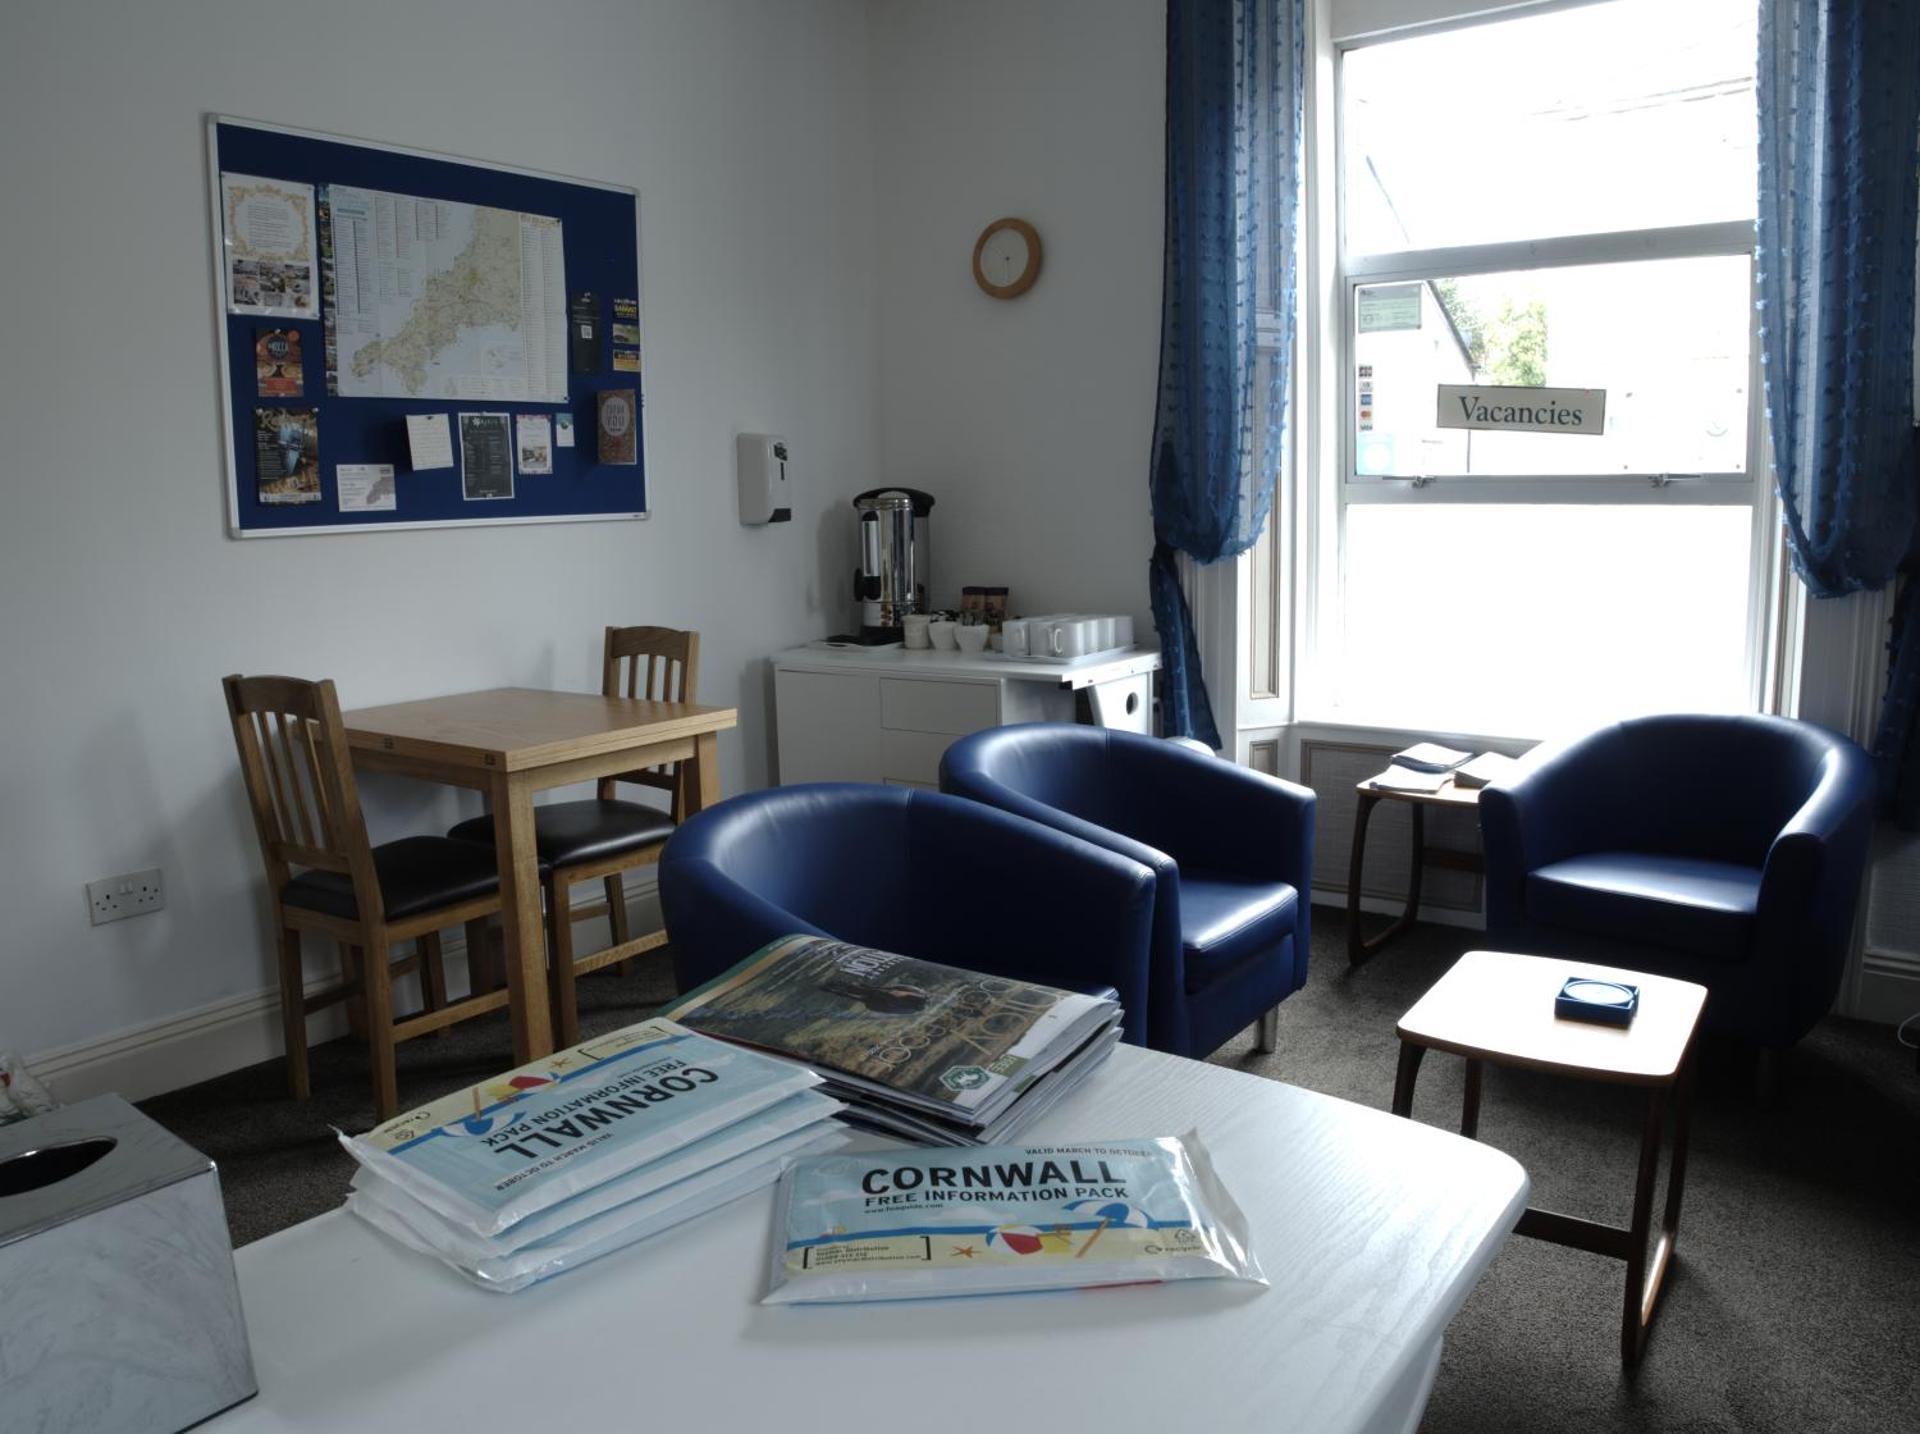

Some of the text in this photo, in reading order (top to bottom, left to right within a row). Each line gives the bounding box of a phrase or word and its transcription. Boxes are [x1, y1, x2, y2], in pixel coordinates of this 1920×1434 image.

[1459, 396, 1584, 426] Vacancies
[648, 1059, 688, 1078] FREE
[494, 1067, 719, 1158] CORNWALL
[532, 1075, 647, 1125] INFORMATION
[481, 1123, 532, 1147] PACK
[1025, 1147, 1054, 1155] VALID
[1056, 1147, 1091, 1155] MARCH
[1094, 1147, 1107, 1155] TO
[861, 1160, 1127, 1195] CORNWALL
[865, 1187, 1129, 1207] FREE INFORMATION PACK
